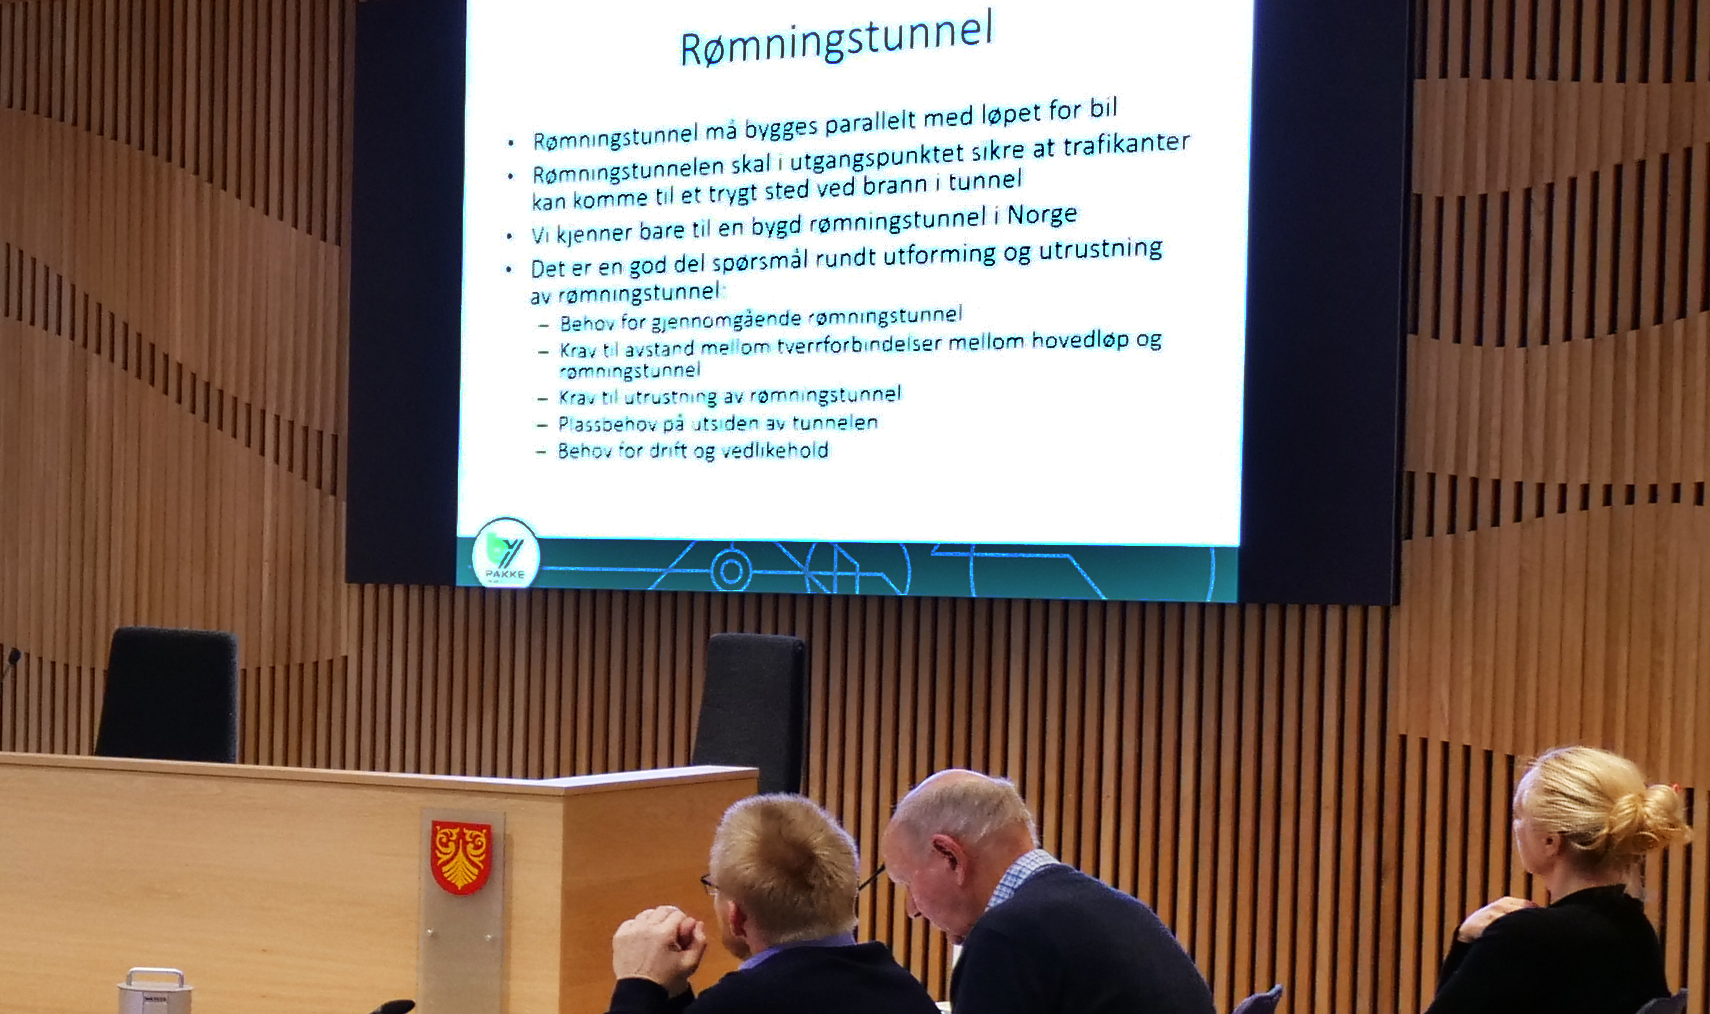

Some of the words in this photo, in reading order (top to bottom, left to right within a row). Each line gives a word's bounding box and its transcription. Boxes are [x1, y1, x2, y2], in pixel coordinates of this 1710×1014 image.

[682, 7, 991, 67] Rømningstunnel
[534, 121, 698, 151] Rømningstunnel
[706, 118, 737, 140] må
[745, 117, 818, 142] bygges
[826, 109, 916, 138] parallelt
[924, 105, 973, 127] med
[982, 103, 1041, 127] løpet
[1050, 99, 1082, 120] for
[1090, 96, 1117, 118] bil
[534, 156, 724, 185] Rømningstunnelen
[731, 152, 770, 175] skal
[791, 143, 965, 172] utgangspunktet
[972, 139, 1024, 161] sikre
[1034, 137, 1056, 158] at
[1064, 132, 1191, 156] trafikanter
[532, 192, 566, 211] kan
[573, 189, 648, 209] komme
[656, 185, 673, 205] til
[681, 187, 702, 204] et
[710, 186, 758, 207] trygt
[765, 178, 809, 200] sted
[817, 176, 855, 197] ved
[864, 176, 927, 196] brann
[936, 173, 940, 191] i
[949, 167, 1022, 190] tunnel
[532, 226, 550, 244] Vi
[557, 224, 633, 248] kjenner
[640, 221, 685, 241] bare
[693, 218, 711, 238] til
[719, 222, 743, 237] en
[752, 214, 801, 239] bygd
[810, 204, 986, 234] rømningstunnel
[994, 205, 999, 225] i
[1008, 204, 1078, 228] Norge
[532, 259, 565, 279] Det
[572, 260, 592, 276] er
[598, 260, 623, 276] en
[629, 255, 667, 279] god
[674, 252, 704, 272] del
[713, 248, 808, 274] spørsmål
[817, 247, 876, 268] rundt
[884, 243, 996, 267] utforming
[1004, 245, 1031, 266] og
[1039, 236, 1163, 261] utrustning
[530, 289, 551, 305] av
[560, 315, 615, 332] Behov
[621, 313, 646, 331] for
[651, 308, 801, 334] gjennomgående
[808, 303, 963, 329] rømningstunnel
[560, 343, 597, 358] Krav
[603, 341, 618, 357] til
[625, 340, 694, 358] avstand
[778, 332, 943, 355] tverrforbindelser
[949, 332, 1024, 350] mellom
[1033, 329, 1129, 352] hovedløp
[1136, 332, 1163, 352] og
[560, 360, 700, 383] rømningstunnel
[559, 390, 596, 405] Krav
[602, 388, 618, 404] til
[624, 388, 717, 408] utrustning
[724, 391, 744, 403] av
[750, 383, 901, 407] rømningstunnel
[663, 413, 684, 434] på
[766, 418, 786, 430] av
[793, 413, 879, 431] tunnelen
[558, 442, 613, 459] Behov
[618, 441, 643, 458] for
[649, 441, 688, 458] drift
[694, 446, 715, 462] og
[722, 440, 829, 459] vedlikehold
[486, 569, 525, 579] PAKKE
